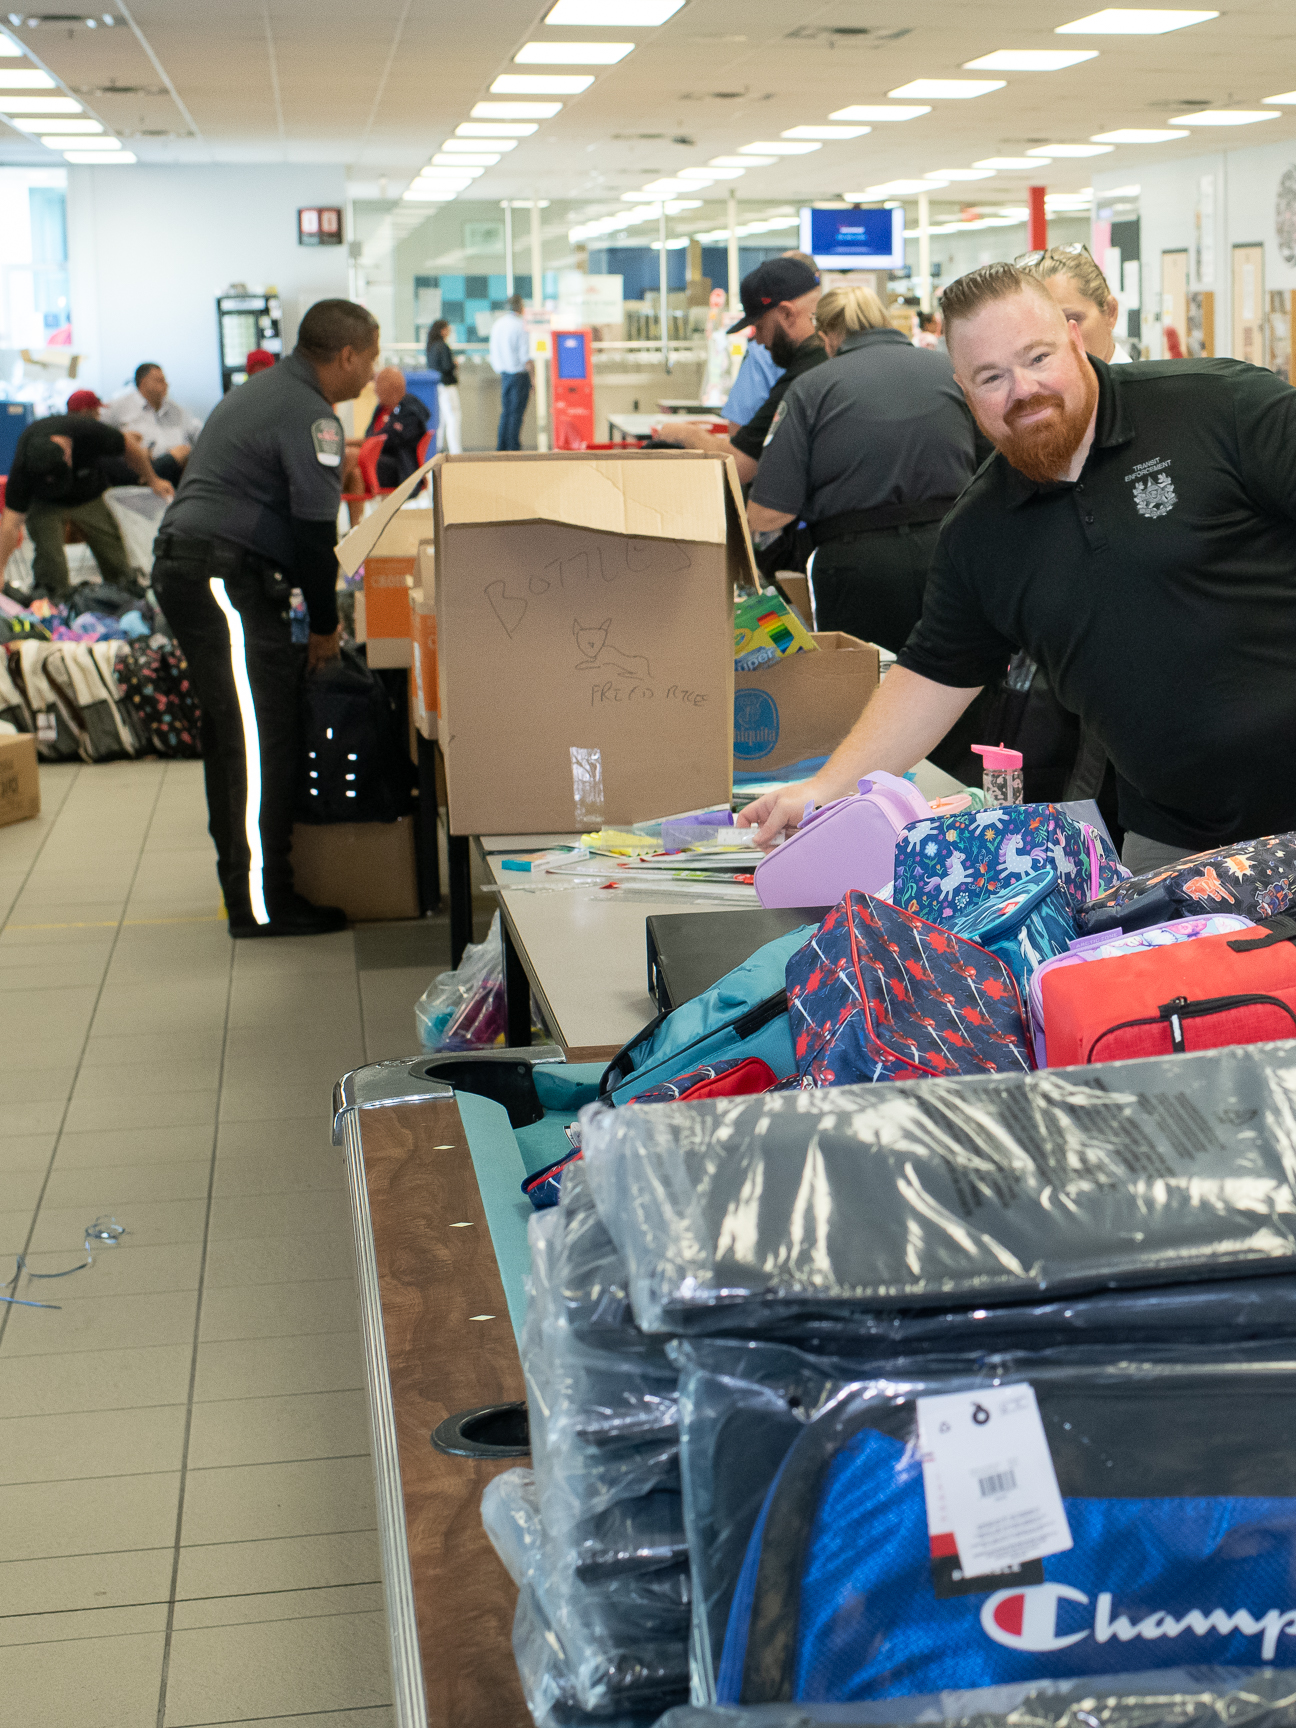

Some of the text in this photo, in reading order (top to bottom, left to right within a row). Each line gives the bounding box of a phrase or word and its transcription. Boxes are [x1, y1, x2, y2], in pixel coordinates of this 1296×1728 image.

[1124, 459, 1172, 483] ENFORCEMENT
[1132, 456, 1161, 472] TRANSIT
[736, 646, 776, 671] uper
[733, 727, 777, 747] hiquita
[1101, 932, 1118, 943] ZONE
